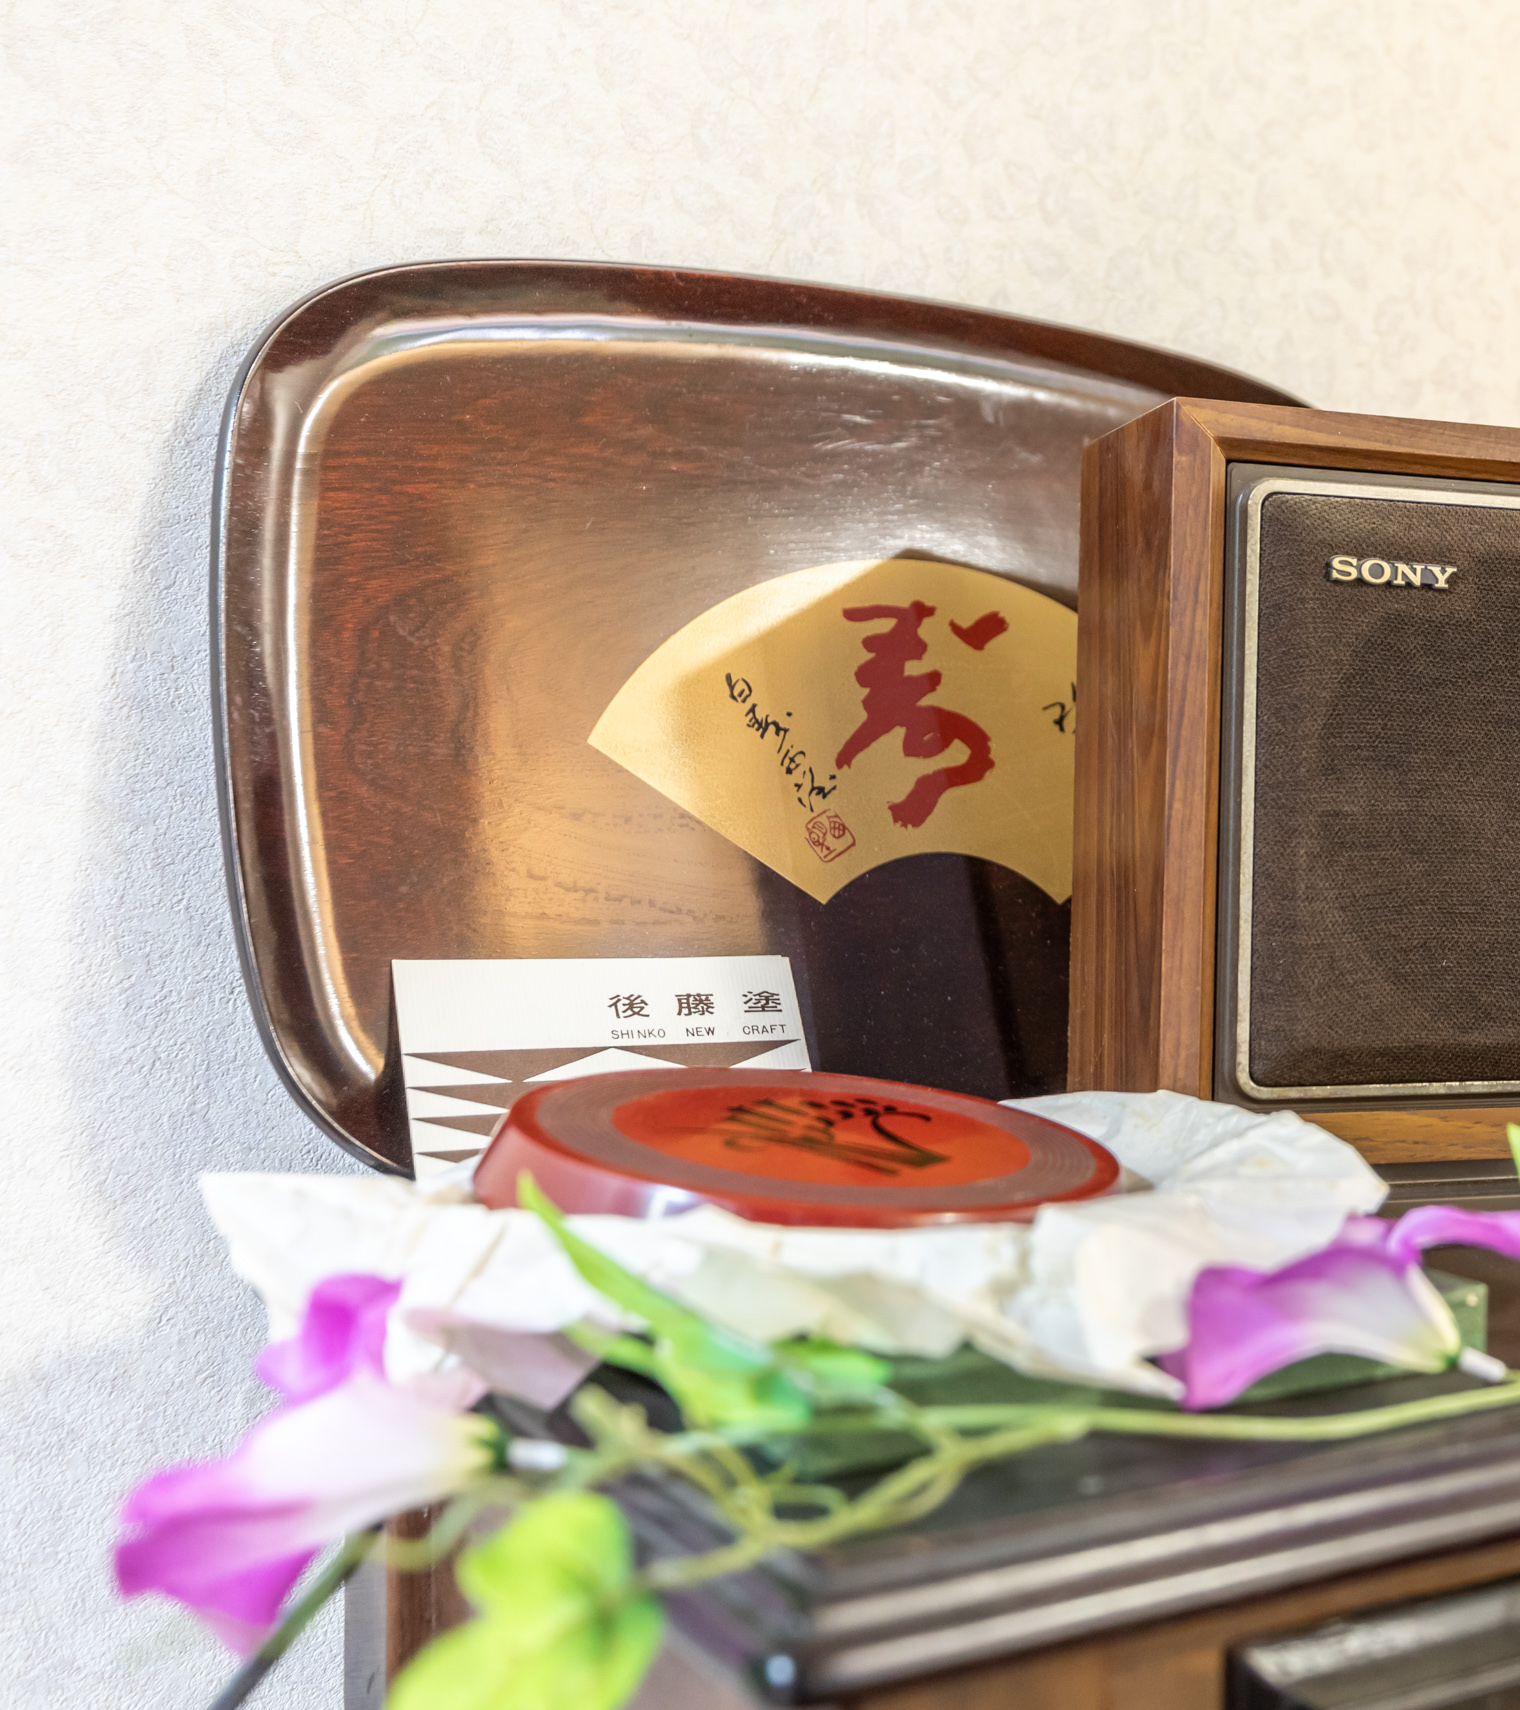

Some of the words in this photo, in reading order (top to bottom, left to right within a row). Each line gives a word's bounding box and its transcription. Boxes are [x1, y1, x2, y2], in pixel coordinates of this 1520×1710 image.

[1331, 555, 1457, 589] SONY
[608, 990, 783, 1019] 後藤塗
[610, 1028, 666, 1040] SHINKO
[685, 1026, 716, 1037] NEW
[742, 1024, 788, 1036] CRAFT
